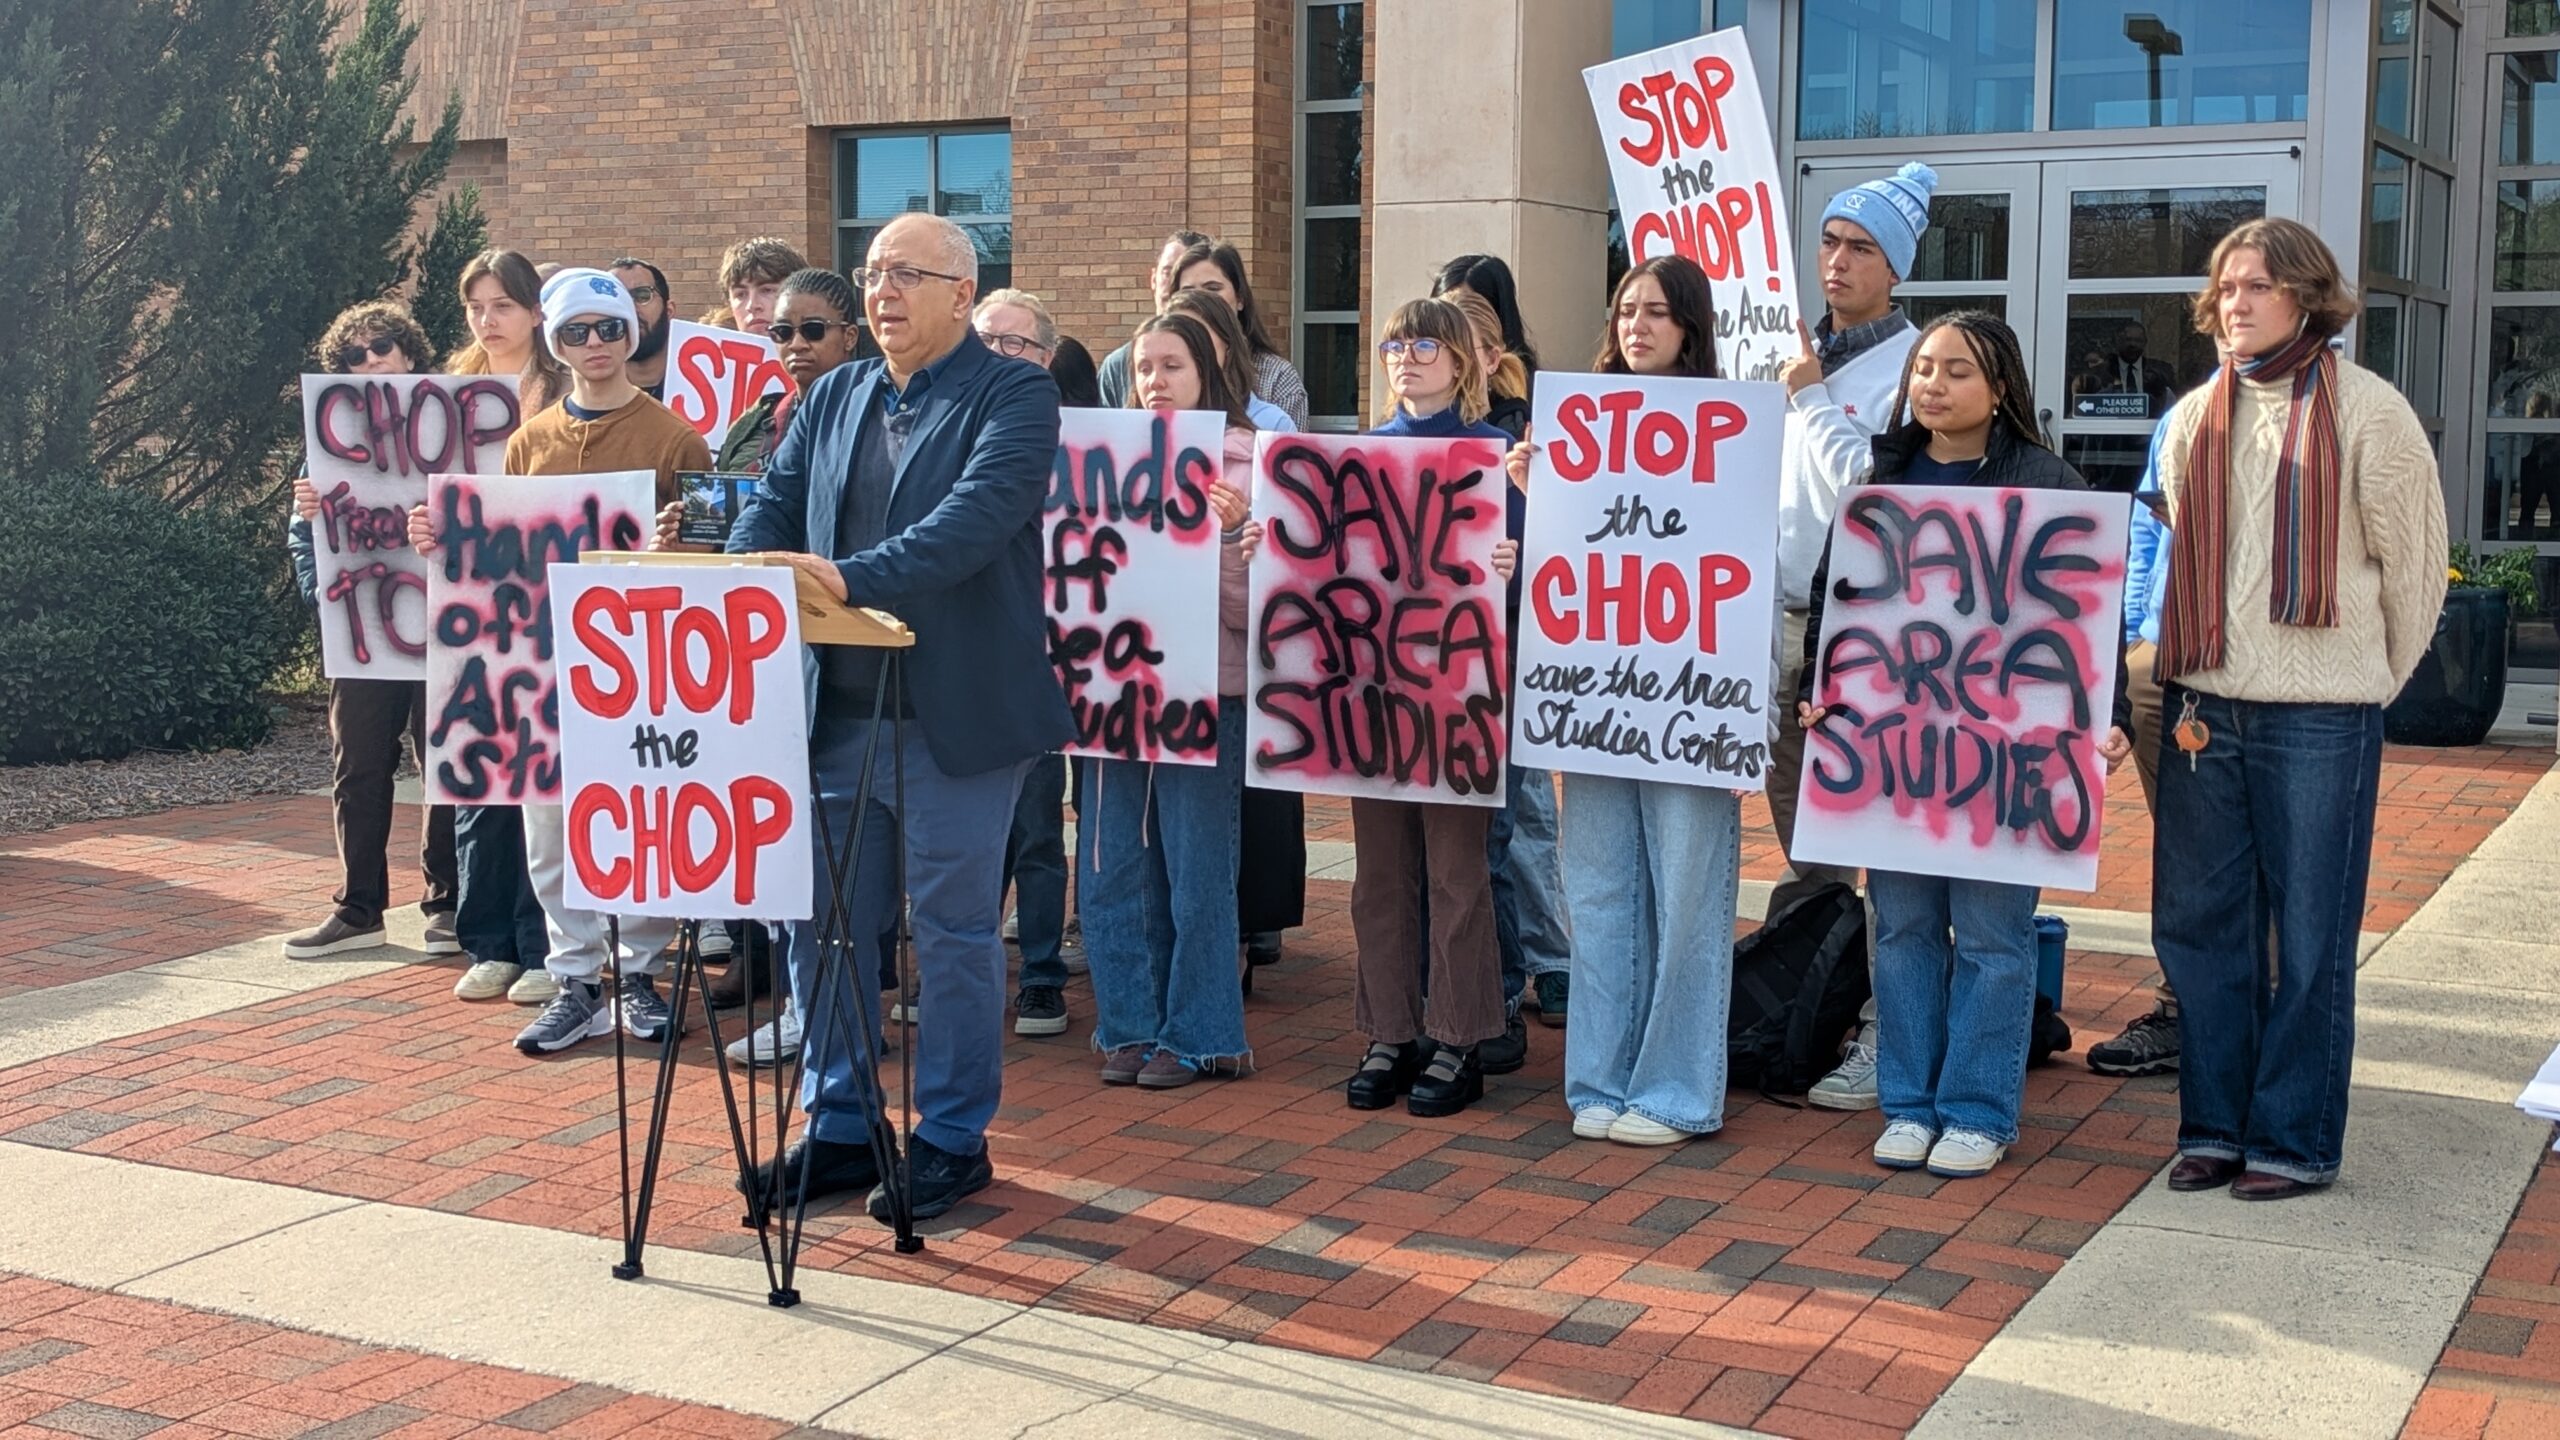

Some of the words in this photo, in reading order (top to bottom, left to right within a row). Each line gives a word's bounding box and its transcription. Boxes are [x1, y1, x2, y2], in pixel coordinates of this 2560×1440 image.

[1619, 57, 1734, 167] STOP
[1660, 160, 1714, 206] the
[1632, 181, 1780, 292] CHOP!
[1739, 285, 1796, 335] Area
[315, 379, 520, 477] CHOP
[1548, 391, 1748, 483] STOP
[2096, 406, 2119, 414] OTHER
[2120, 406, 2144, 414] DOOR
[2102, 398, 2128, 407] PLEASE
[2129, 398, 2144, 407] USE
[1272, 446, 1484, 590] SAVE
[1585, 494, 1688, 543] the
[1833, 494, 2101, 626] SAVE
[1259, 577, 1501, 698] AREA
[1531, 552, 1752, 655] CHOP
[569, 586, 788, 725] STOP
[1523, 663, 1598, 697] save
[1598, 654, 1663, 702] the
[1663, 656, 1763, 714] Area
[1822, 620, 2091, 731] AREA
[629, 724, 699, 768] the
[1255, 675, 1504, 795] STUDIES
[1523, 697, 1660, 764] Studies
[1661, 710, 1766, 779] Centers
[1812, 703, 2092, 852] STUDIES
[568, 775, 793, 905] CHOP
